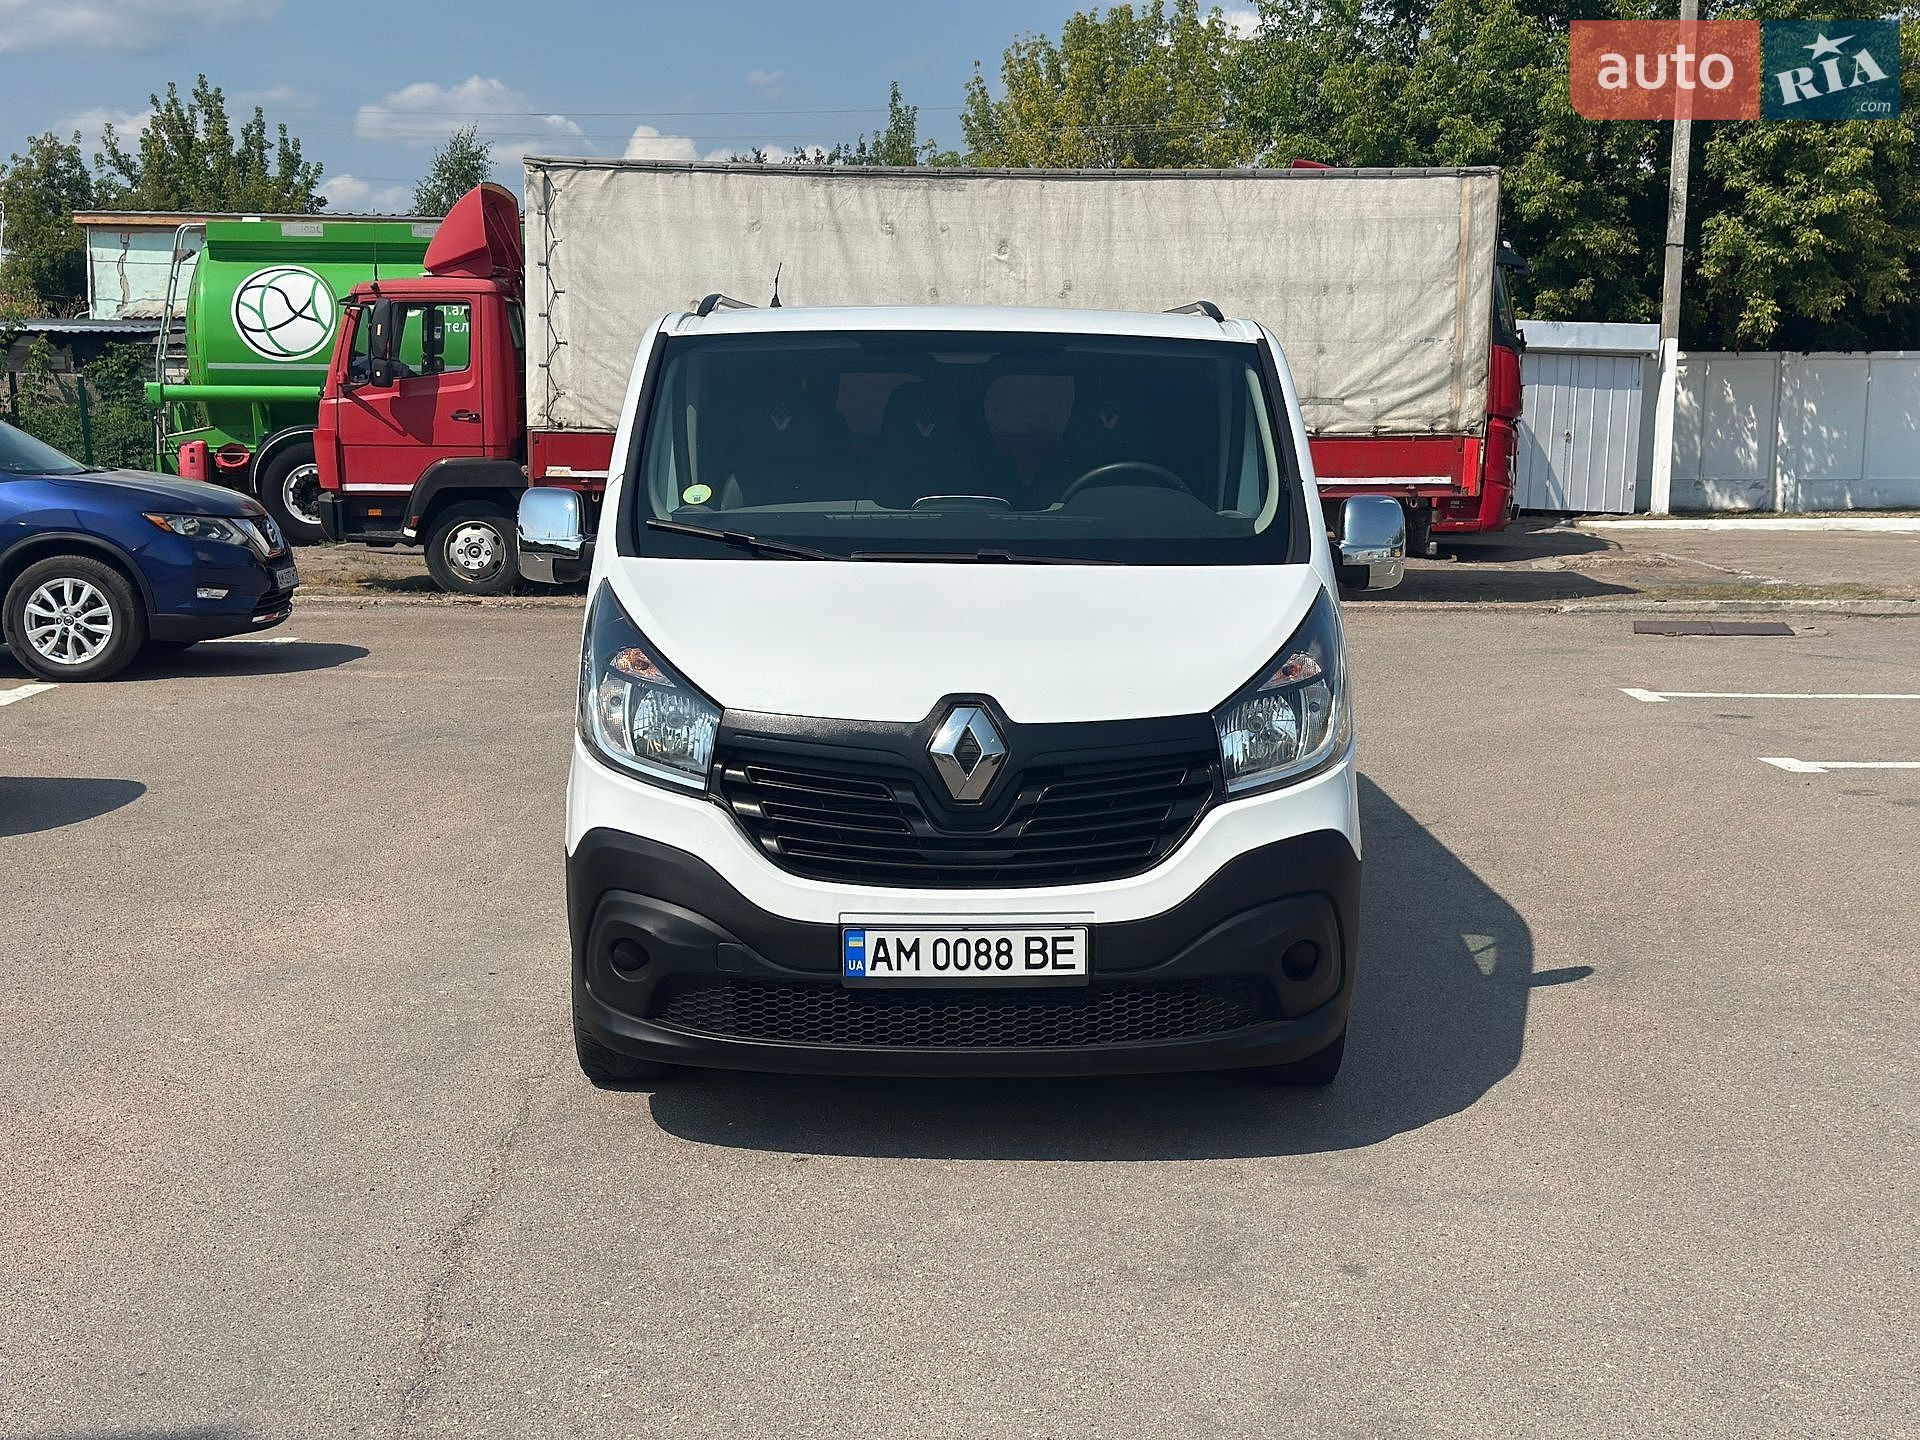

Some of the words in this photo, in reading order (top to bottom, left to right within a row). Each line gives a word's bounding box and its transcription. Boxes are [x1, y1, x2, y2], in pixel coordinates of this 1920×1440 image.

[869, 937, 921, 971] AM
[932, 937, 1013, 971] 0088
[1024, 935, 1076, 970] BE
[848, 960, 863, 971] UA
